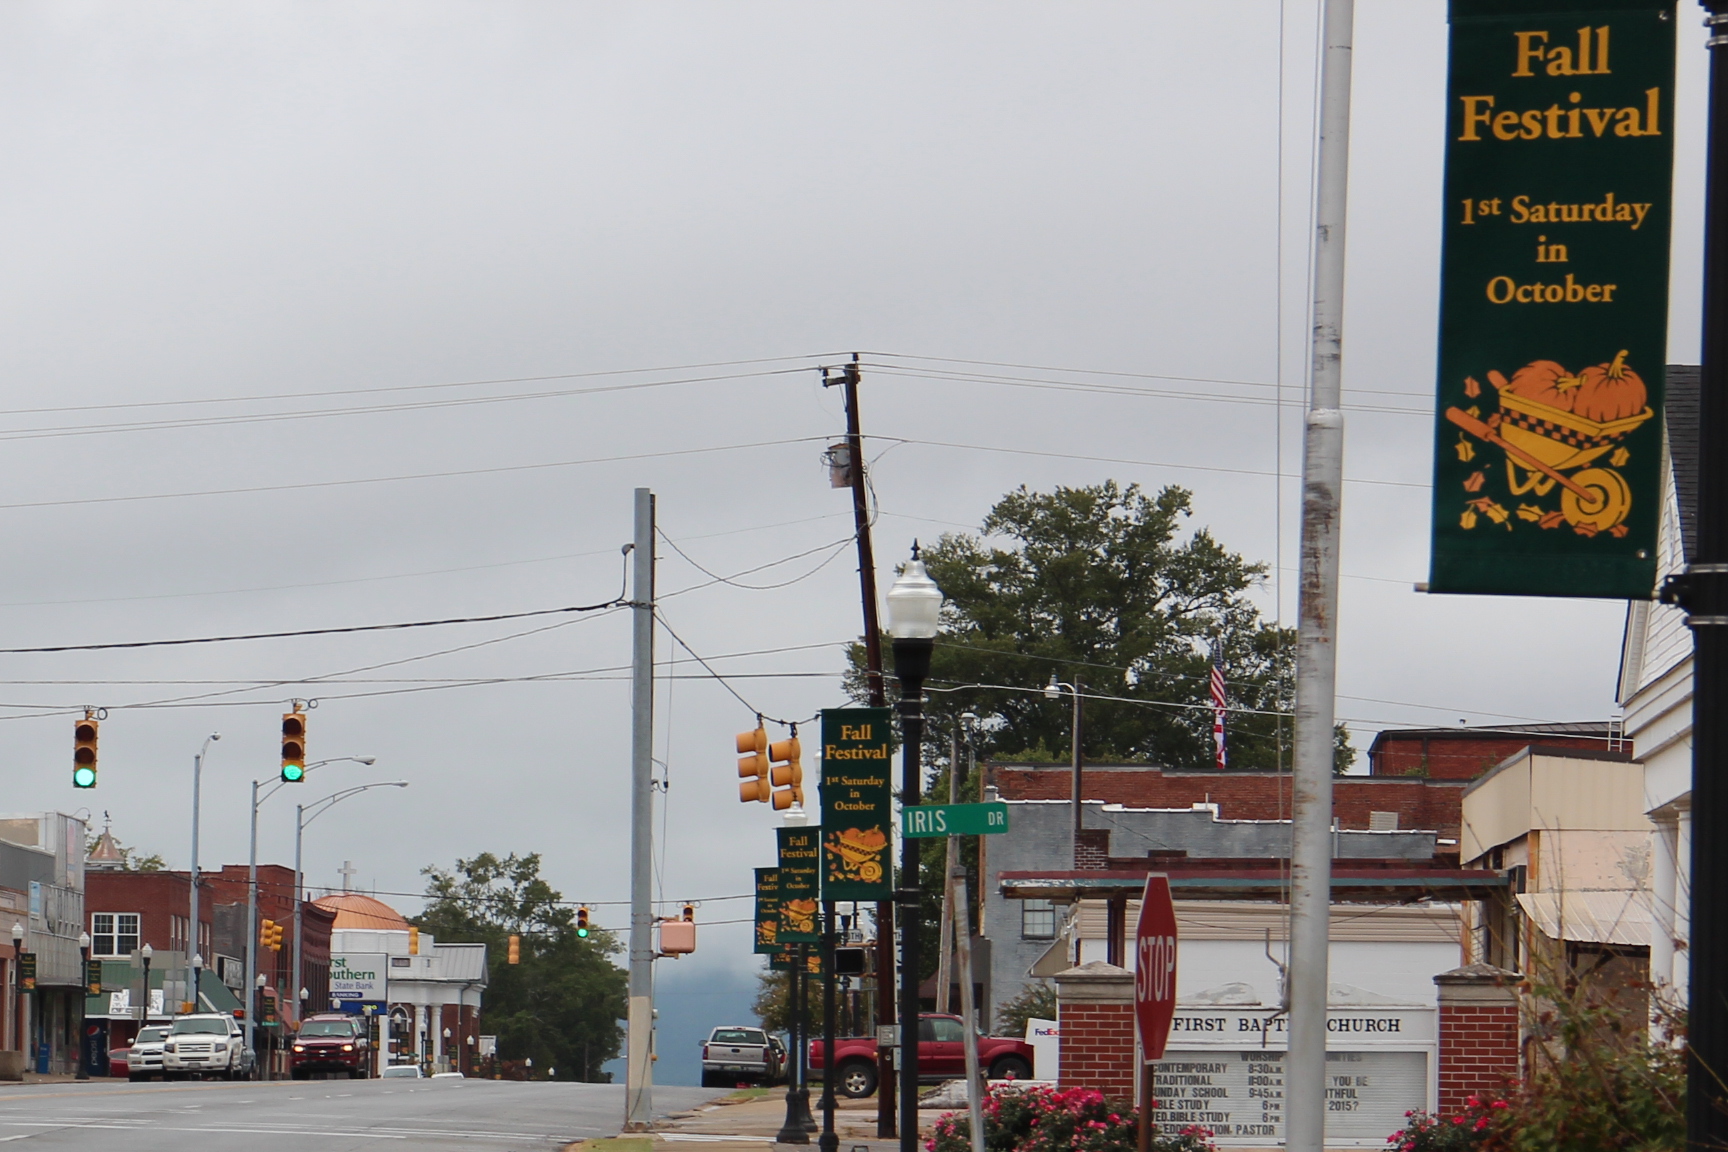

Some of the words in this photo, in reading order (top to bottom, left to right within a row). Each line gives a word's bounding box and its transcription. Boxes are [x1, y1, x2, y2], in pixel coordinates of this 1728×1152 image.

[1511, 25, 1611, 78] Fall
[1458, 87, 1661, 141] Festival
[1460, 196, 1502, 224] 1st
[1511, 193, 1652, 230] Saturday
[1536, 236, 1568, 263] in
[1486, 275, 1616, 304] October
[841, 724, 872, 741] Fall
[825, 744, 887, 760] Festival
[826, 776, 839, 785] 1st
[841, 776, 885, 787] Saturday
[849, 788, 860, 798] in
[834, 801, 875, 811] October
[908, 810, 946, 833] IRIS
[988, 811, 1004, 826] DR
[789, 836, 808, 846] Fall
[780, 848, 817, 858] Festival
[329, 957, 347, 967] rst
[1138, 935, 1175, 1003] STOP
[1173, 1018, 1226, 1031] FIRST
[1238, 1018, 1288, 1031] BAPT
[1327, 1018, 1400, 1032] CHURCH
[90, 1040, 99, 1066] pepsi
[1153, 1063, 1227, 1073] CONTEMPORARY
[1333, 1076, 1351, 1086] YOU
[1153, 1087, 1186, 1098] UNDAY
[1192, 1087, 1228, 1098] SCHOOL
[1325, 1088, 1358, 1098] ITHFUL
[1157, 1100, 1175, 1109] BLE
[1177, 1100, 1210, 1110] STUDY
[1329, 1101, 1359, 1111] 2015?
[1199, 1112, 1230, 1122] STUDY
[1236, 1124, 1275, 1135] PASTOR
